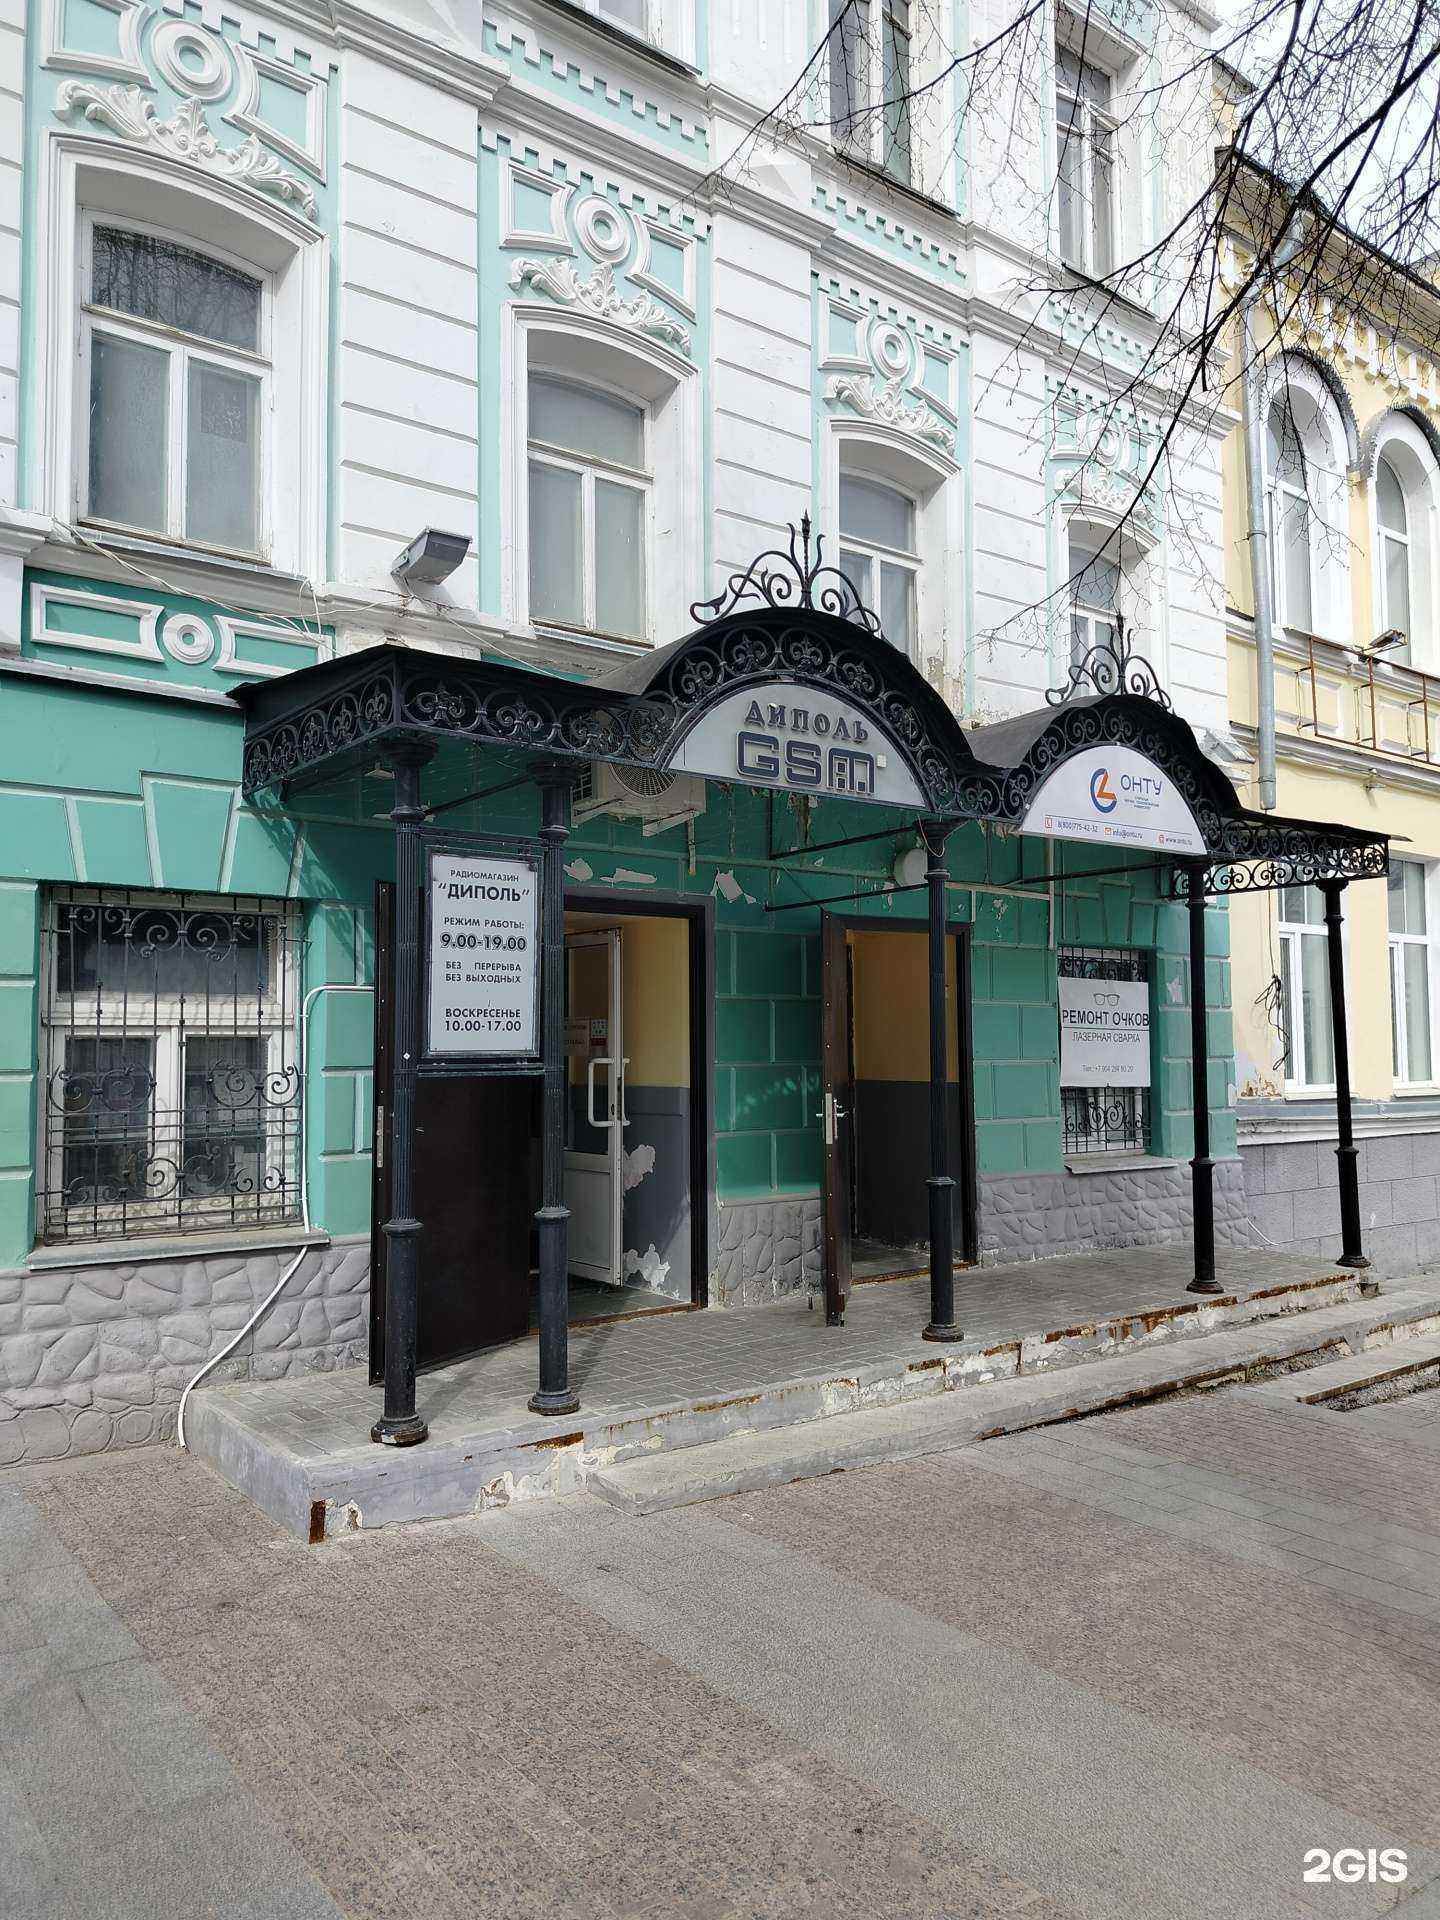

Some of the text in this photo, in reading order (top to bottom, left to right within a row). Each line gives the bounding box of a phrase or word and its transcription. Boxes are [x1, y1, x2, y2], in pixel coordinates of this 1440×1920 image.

[744, 700, 868, 743] ДИПОЛЬ
[737, 731, 874, 793] GSM
[1121, 774, 1162, 795] ОНТУ
[450, 869, 519, 882] РАДИОМАГАЗИН
[444, 917, 525, 929] РЕЖИМ РАБОТЫ:
[441, 933, 526, 951] 9.00-19.00
[446, 961, 522, 972] БЕЗ ПЕРЕРЫВА
[445, 973, 521, 984] БЕЗ ВЫХОДНЫХ
[445, 1008, 521, 1018] ВОСКРЕСЕНЬЕ
[1062, 1009, 1150, 1026] РЕМОНТ ОЧКОВ
[445, 1020, 521, 1032] 10.00-17.00
[1072, 1032, 1141, 1043] ЛАЗЕРНАЯ СВАРКА
